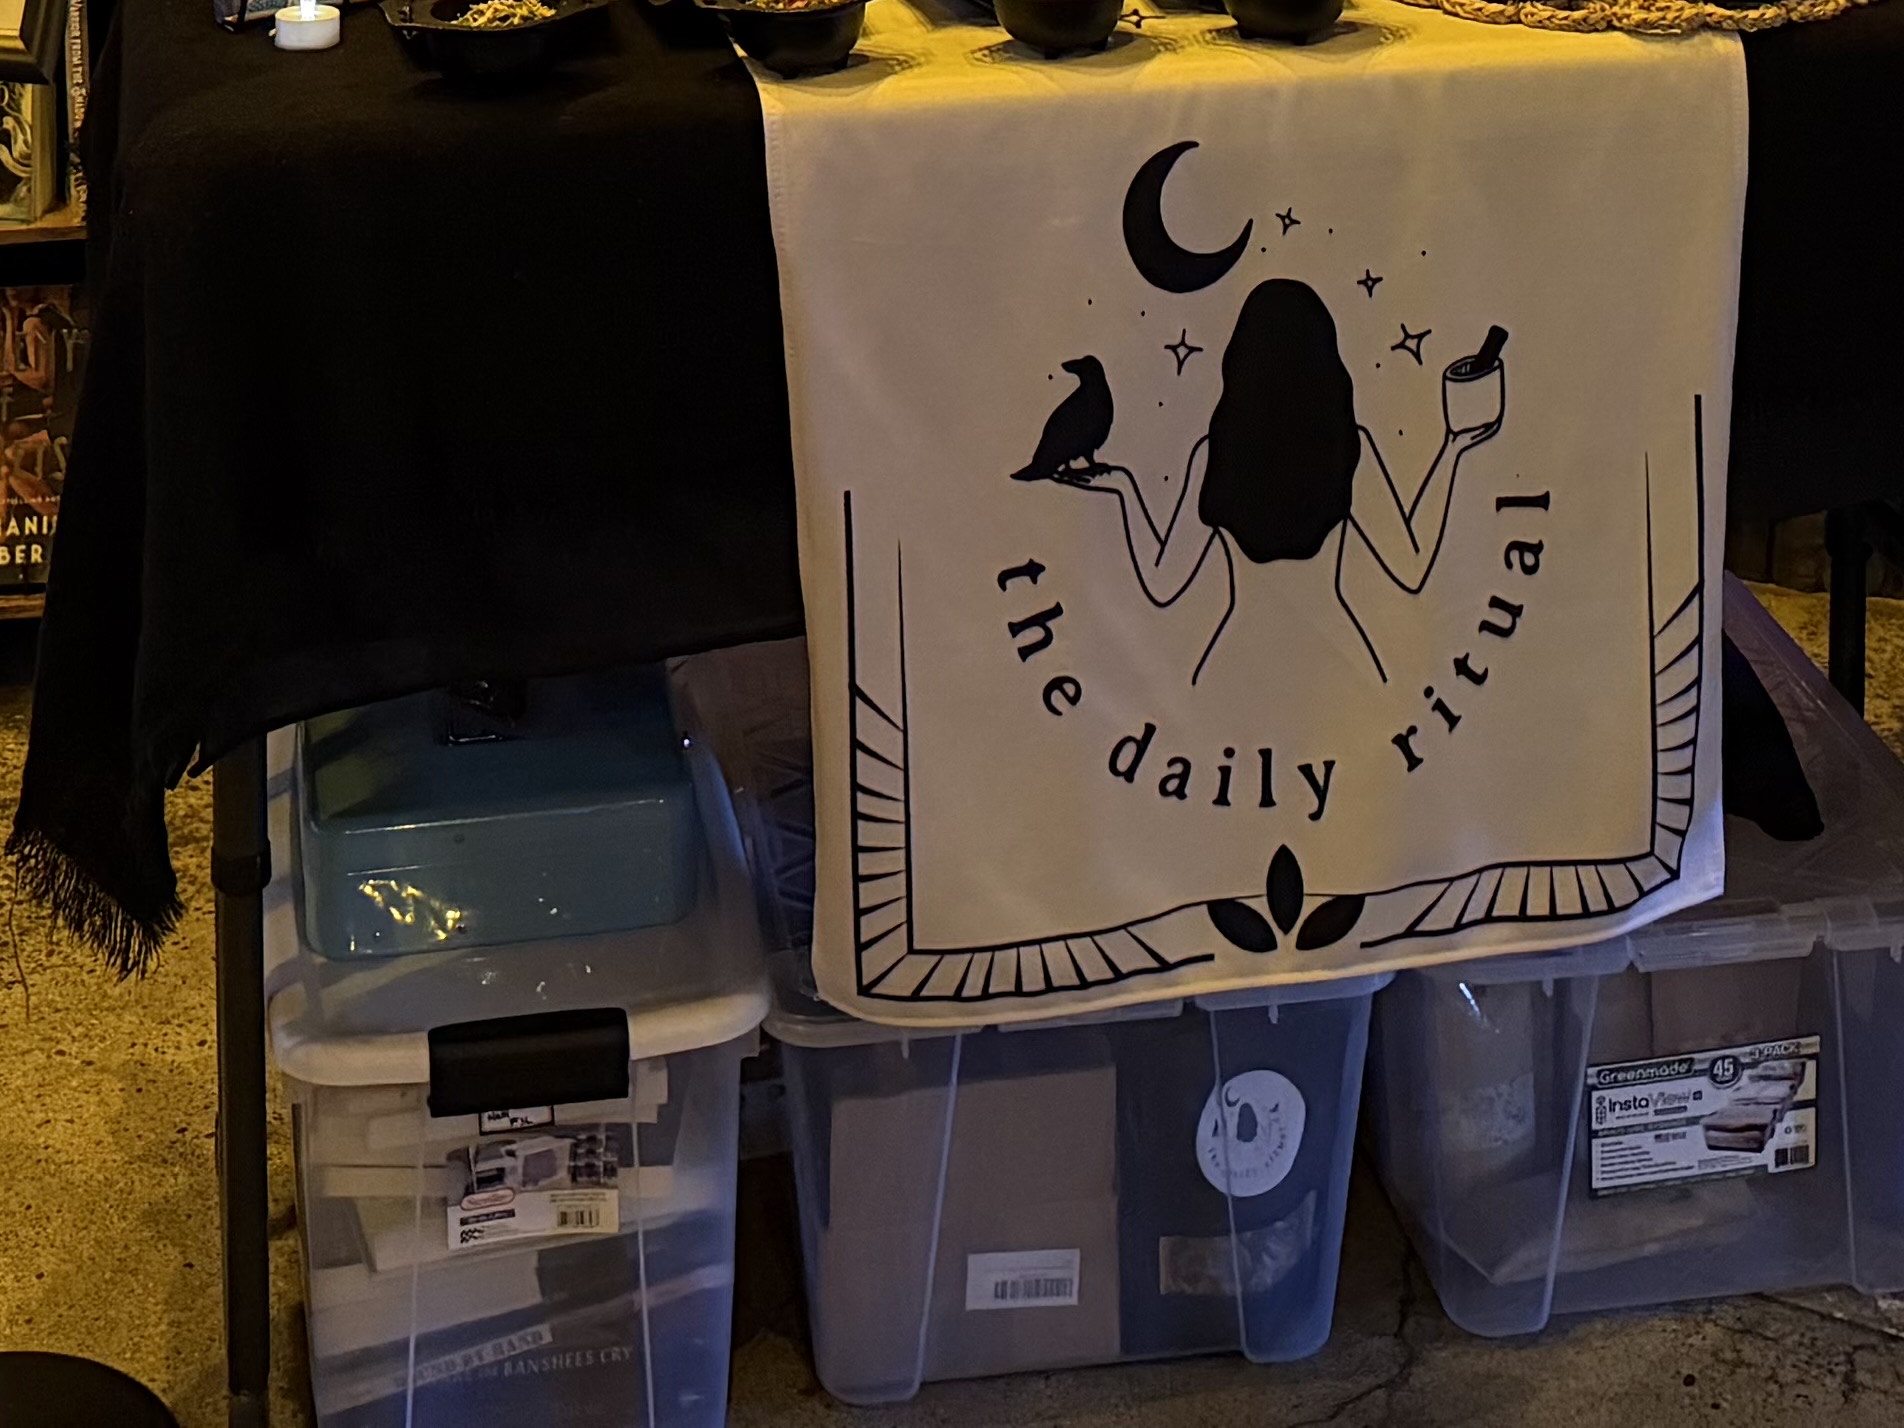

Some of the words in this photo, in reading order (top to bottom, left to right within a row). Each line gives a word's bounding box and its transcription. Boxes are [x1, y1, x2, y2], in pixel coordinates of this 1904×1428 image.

[995, 555, 1084, 720] the
[1105, 720, 1337, 822] daily
[1388, 486, 1553, 776] ritual
[1599, 1060, 1690, 1084] Greenmade
[1712, 1058, 1734, 1077] 45
[503, 1349, 595, 1377] BANSHEES
[600, 1345, 632, 1364] CRY
